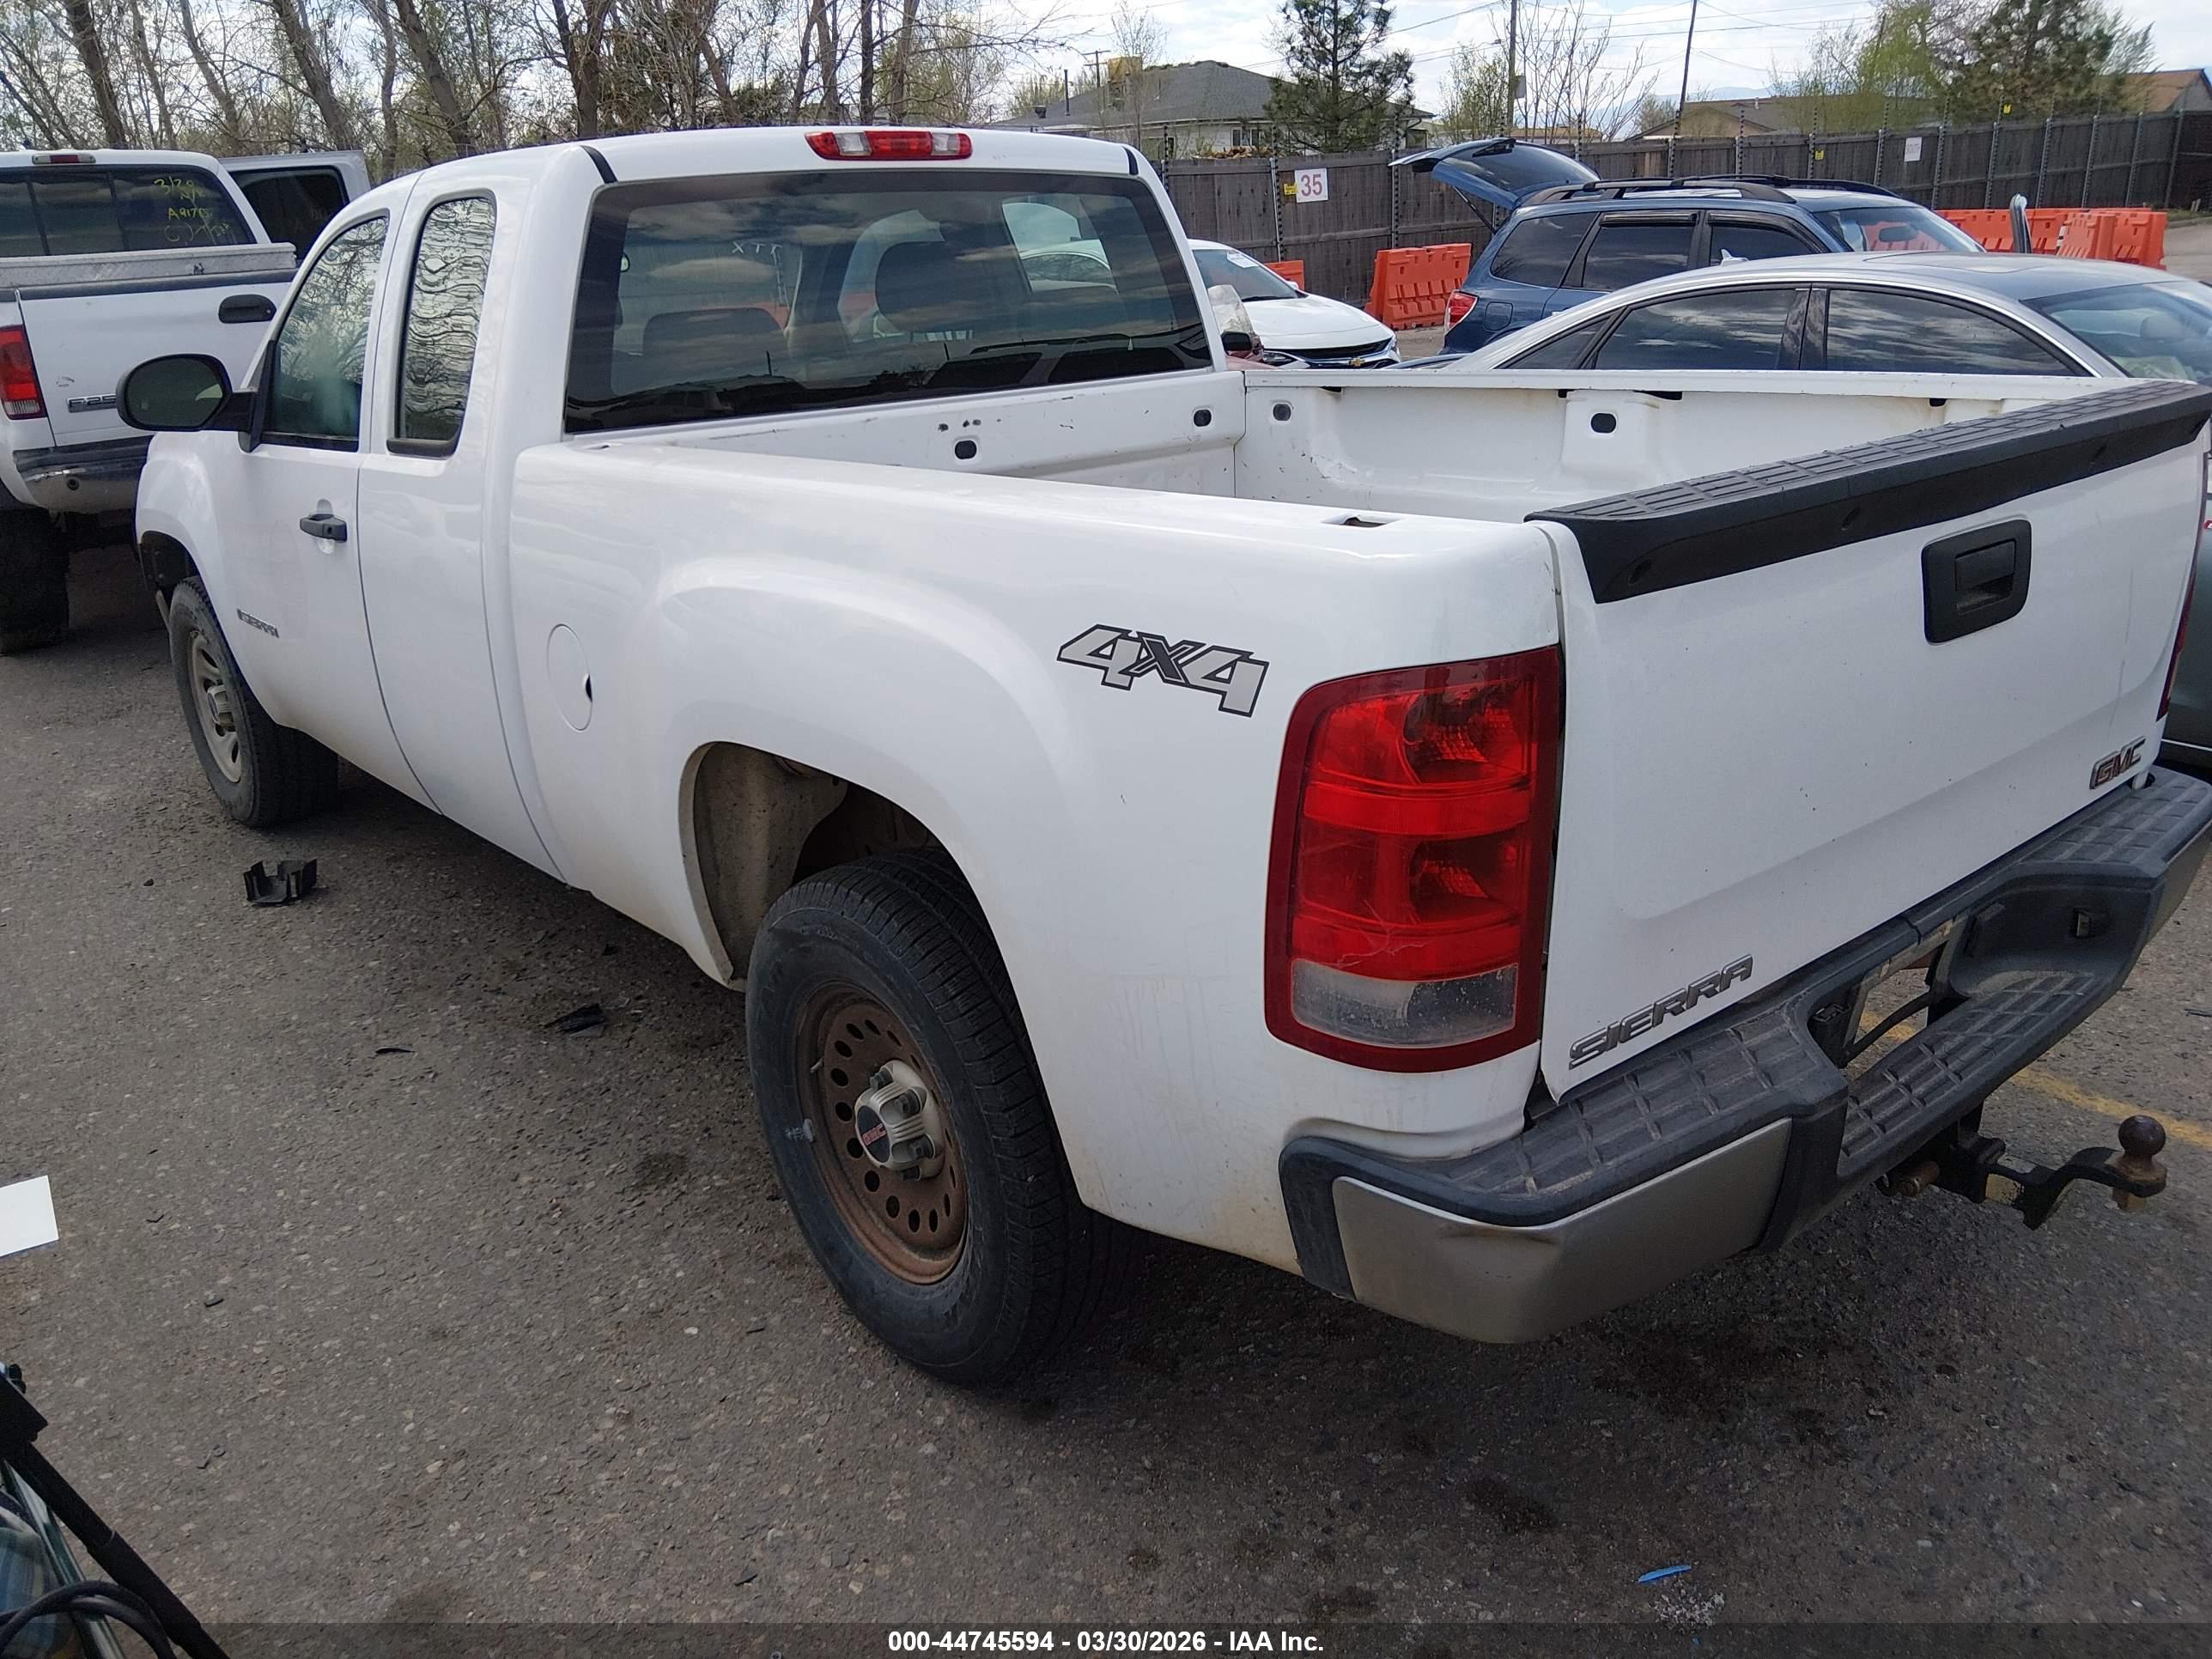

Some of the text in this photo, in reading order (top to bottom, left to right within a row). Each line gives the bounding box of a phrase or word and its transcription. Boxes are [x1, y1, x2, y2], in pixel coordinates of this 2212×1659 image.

[1301, 173, 1322, 197] 35
[69, 394, 117, 409] F-25
[2088, 735, 2146, 790] GMC
[1569, 953, 1753, 1070] SIERRA
[862, 1122, 887, 1146] GMC
